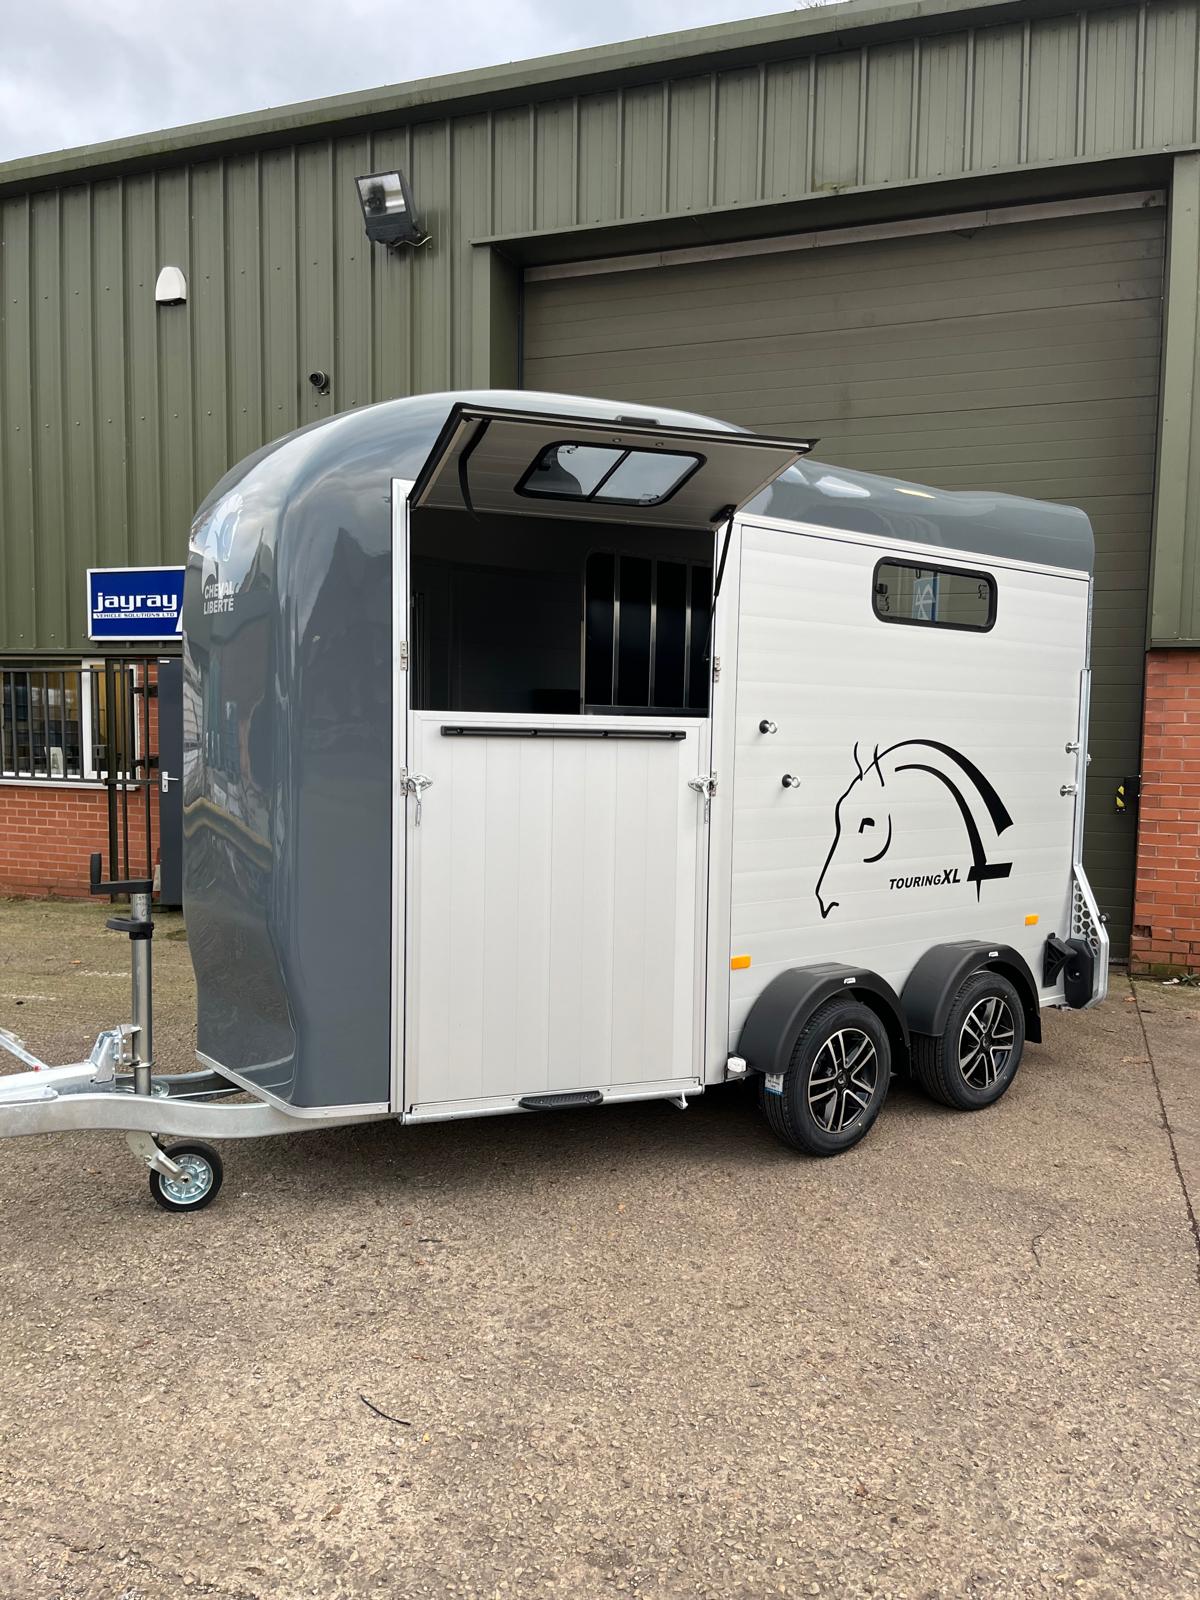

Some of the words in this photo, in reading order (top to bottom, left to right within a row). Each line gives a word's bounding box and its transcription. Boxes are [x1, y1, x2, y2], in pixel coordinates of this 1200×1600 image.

[204, 581, 235, 599] CHEVAL
[93, 592, 177, 612] jayray
[203, 595, 234, 615] LIBERTÉ
